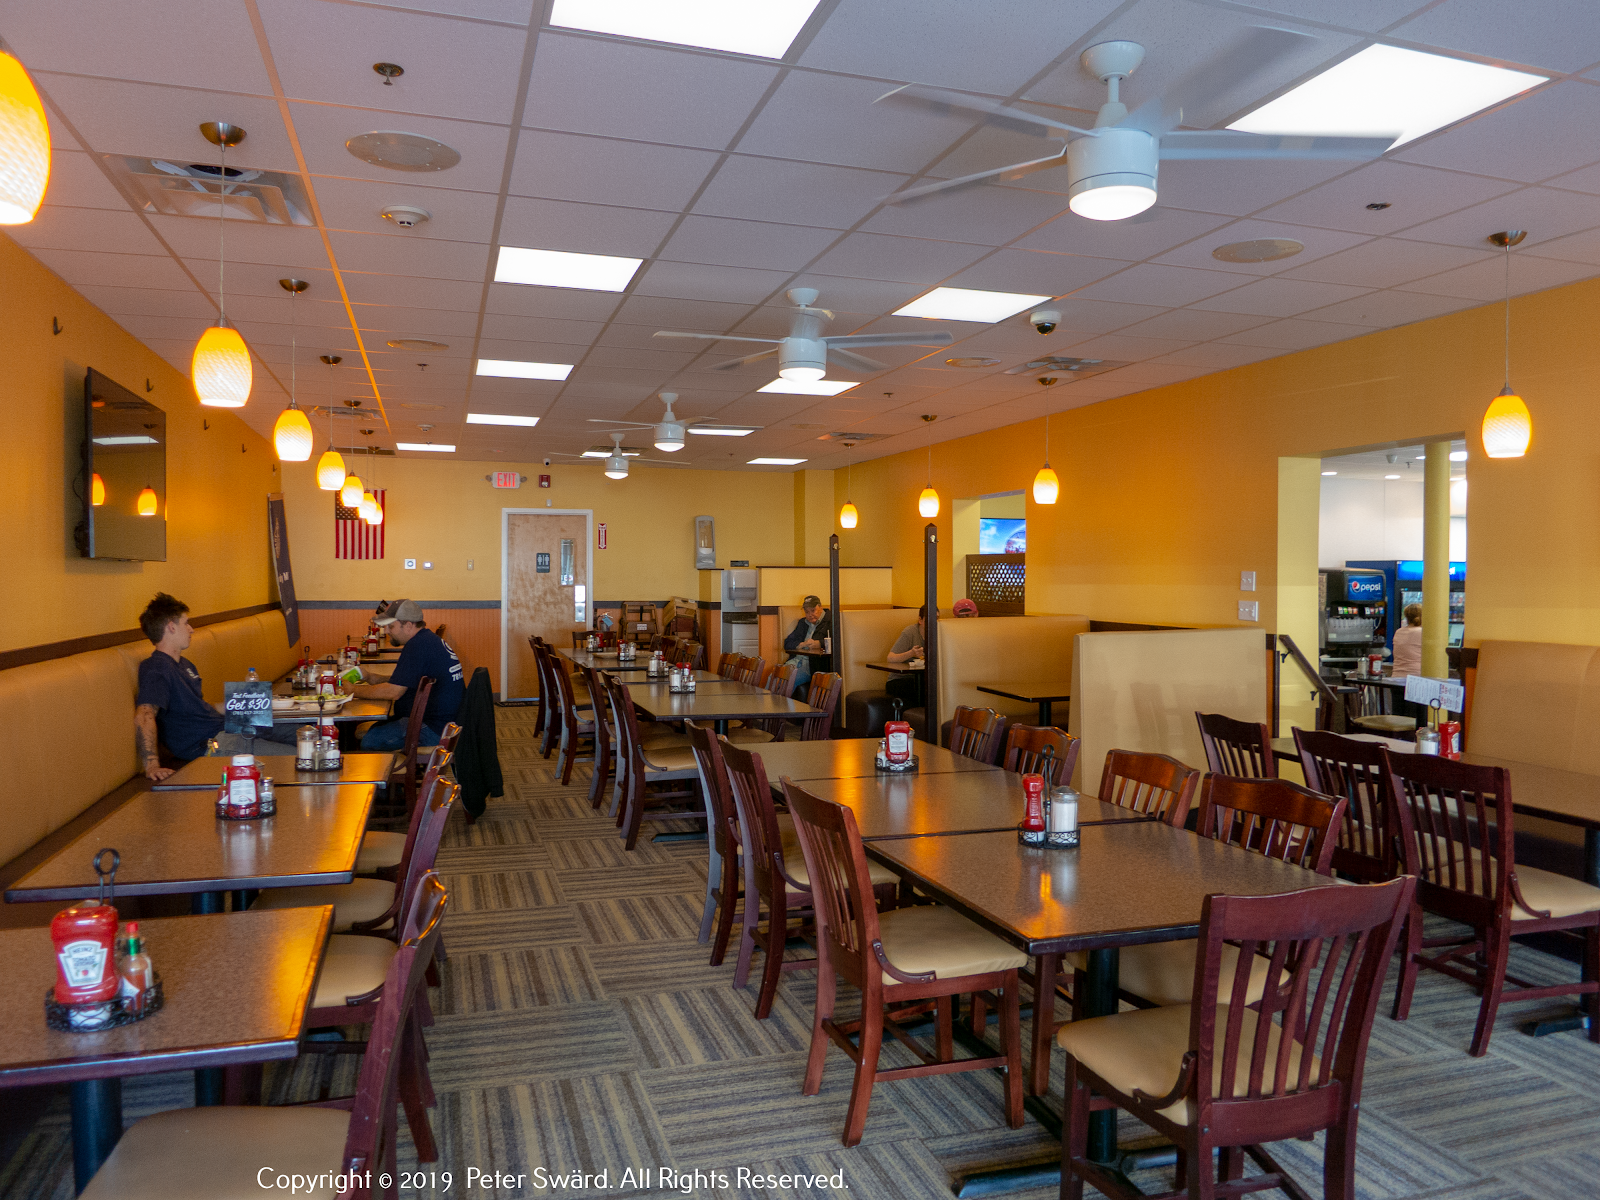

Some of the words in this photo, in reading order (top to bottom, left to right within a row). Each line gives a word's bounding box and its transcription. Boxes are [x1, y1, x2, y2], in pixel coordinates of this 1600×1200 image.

[496, 472, 517, 488] EXIT
[1360, 582, 1381, 593] pepsi
[226, 699, 246, 711] Get
[248, 698, 271, 710] $30
